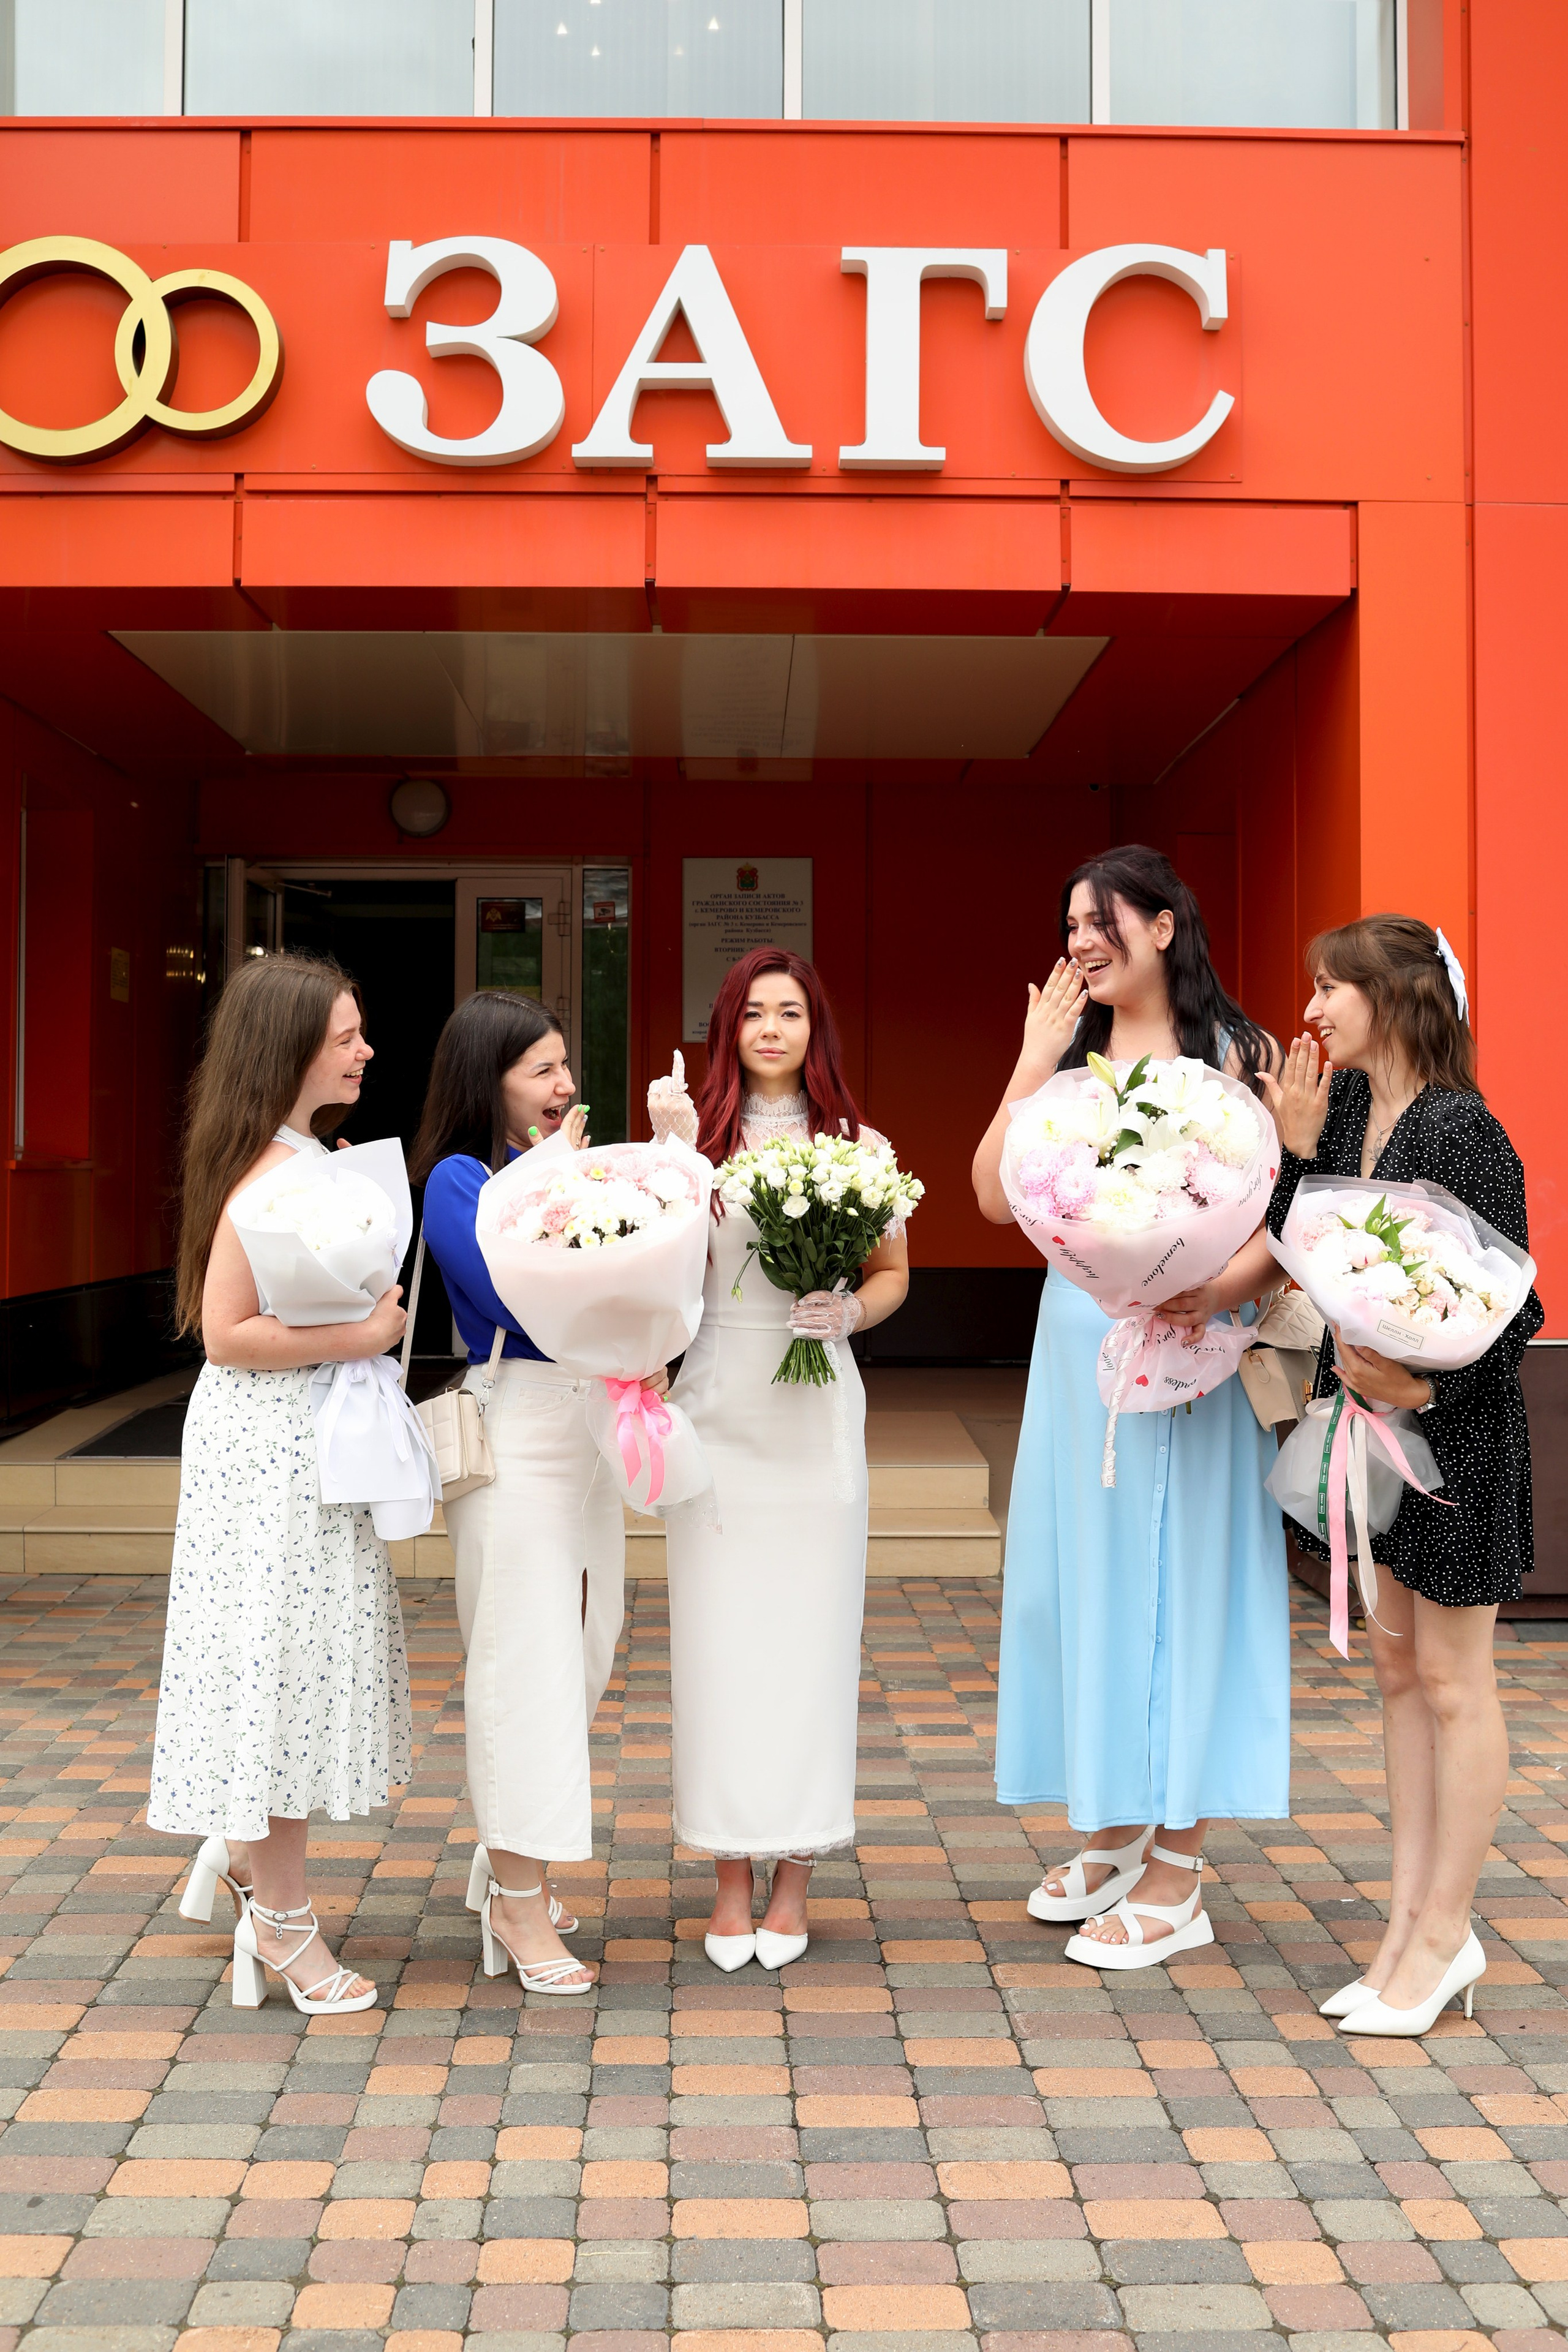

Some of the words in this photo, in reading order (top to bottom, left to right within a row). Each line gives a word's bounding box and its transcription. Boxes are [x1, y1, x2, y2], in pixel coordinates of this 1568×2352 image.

[366, 235, 1235, 474] ЗАГС
[1142, 1237, 1185, 1287] bemelove
[1382, 1324, 1401, 1335] Шелли
[1404, 1334, 1419, 1343] Холл
[1102, 1352, 1115, 1371] love
